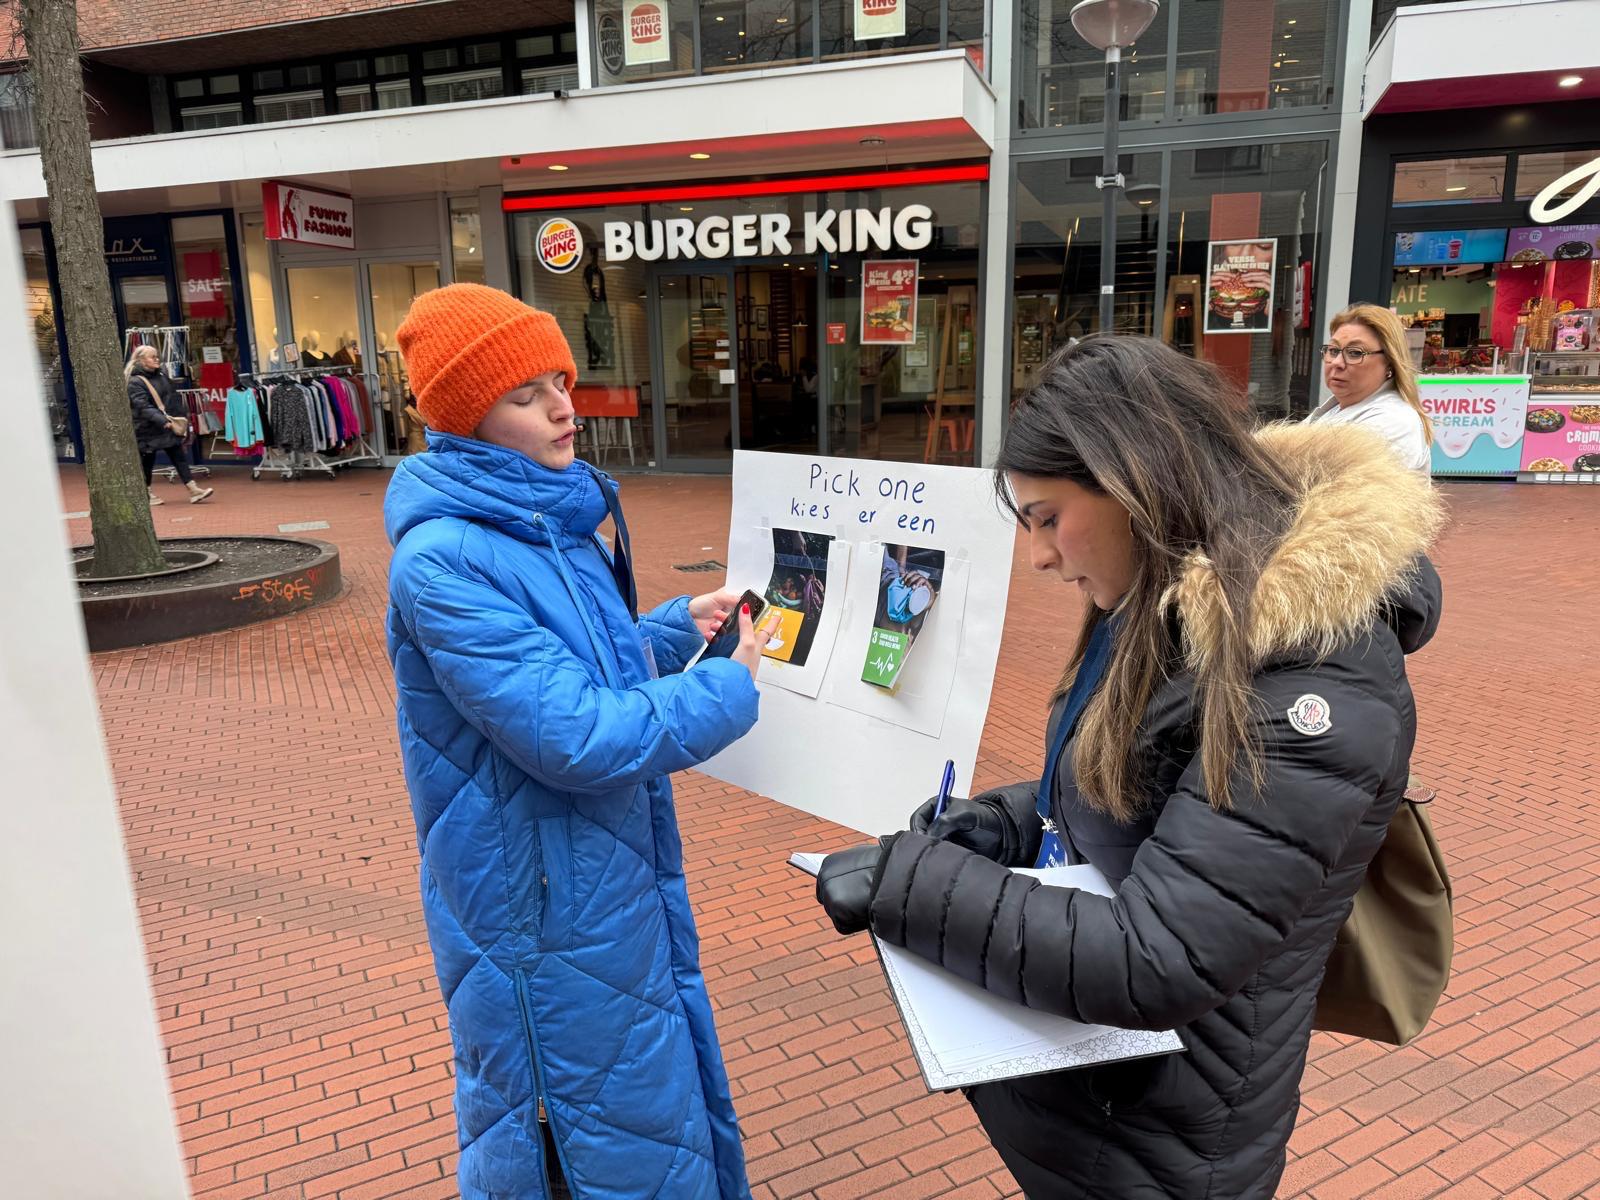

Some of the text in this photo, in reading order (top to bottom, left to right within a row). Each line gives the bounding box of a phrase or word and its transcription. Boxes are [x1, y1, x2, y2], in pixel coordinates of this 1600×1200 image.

[631, 15, 661, 26] BURGER
[631, 24, 662, 37] KING
[601, 40, 622, 57] KING
[308, 205, 347, 223] FUNNY
[304, 219, 352, 238] FASHION
[604, 204, 932, 261] BURGER KING
[542, 229, 575, 247] BURGER
[544, 238, 576, 260] KING
[188, 278, 222, 293] SALE
[1391, 284, 1428, 303] ATE
[203, 387, 228, 402] SAL
[1422, 397, 1496, 414] SWIRL'S
[1443, 415, 1494, 427] CREAM
[1566, 430, 1600, 443] CRUM
[810, 463, 925, 503] Pick one
[791, 498, 935, 534] kies er een
[872, 631, 878, 644] 3
